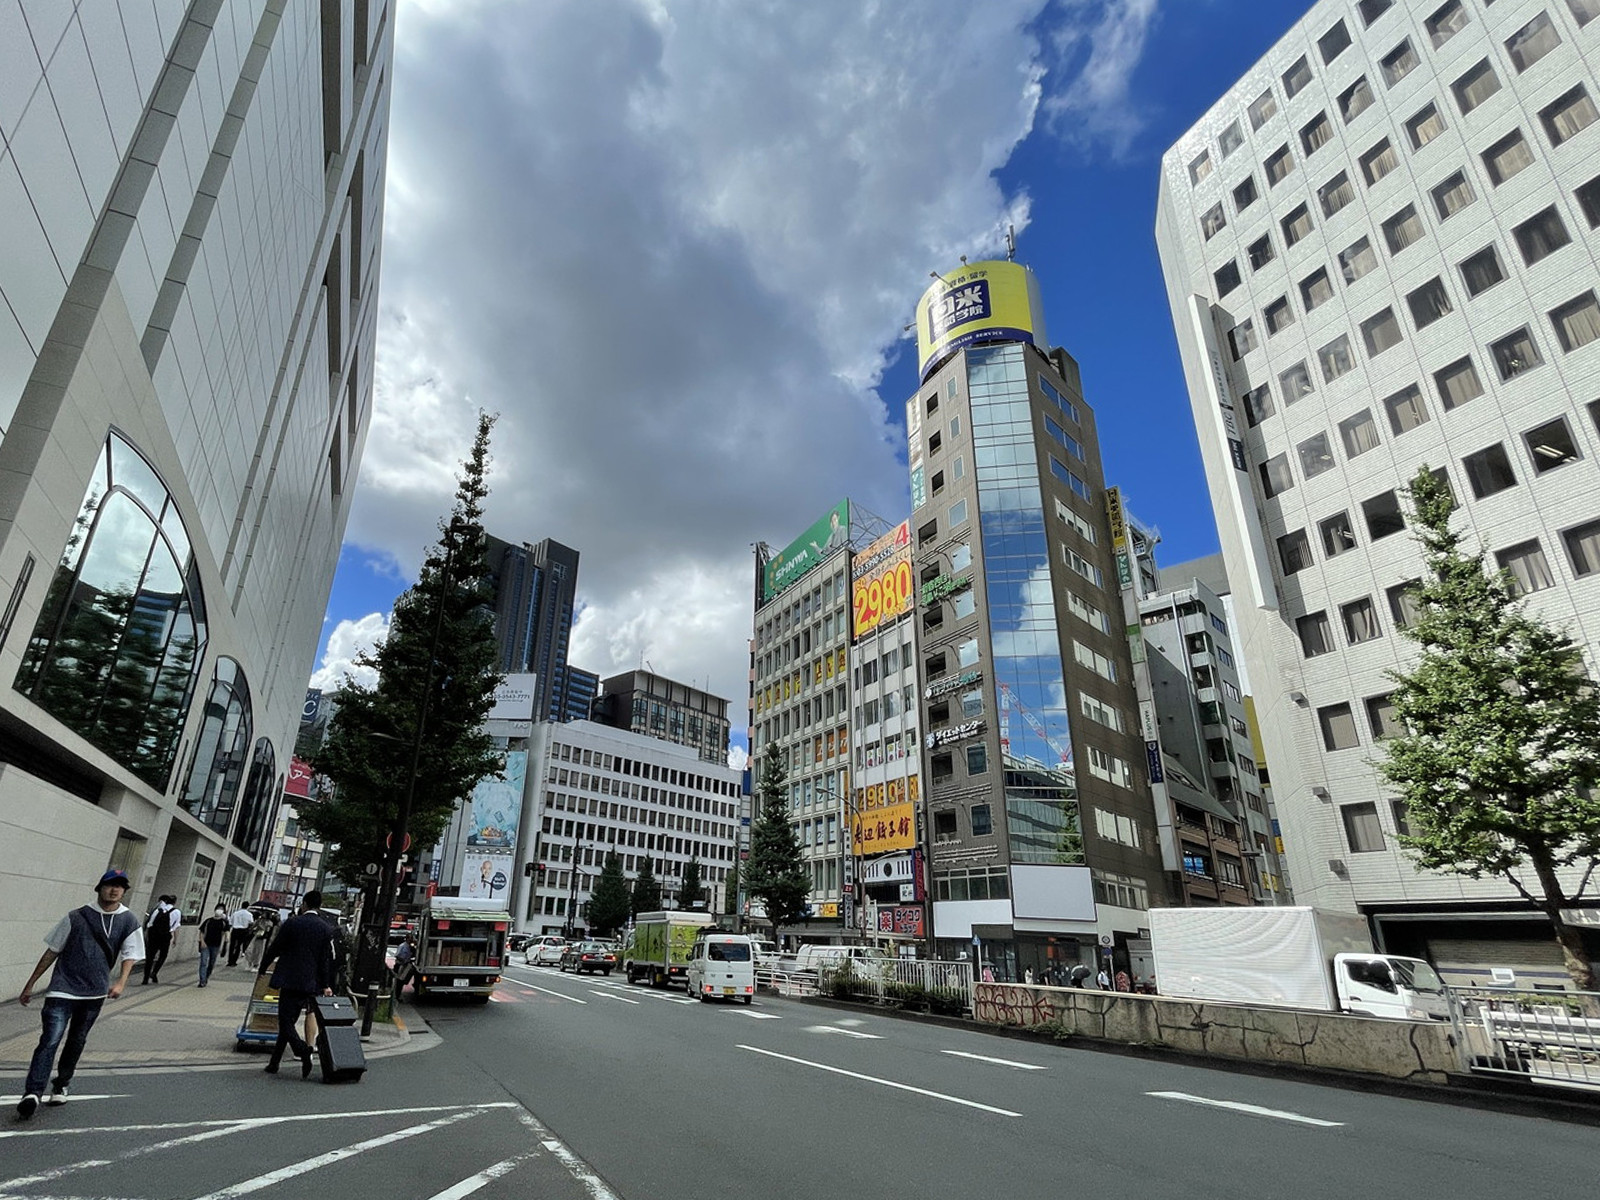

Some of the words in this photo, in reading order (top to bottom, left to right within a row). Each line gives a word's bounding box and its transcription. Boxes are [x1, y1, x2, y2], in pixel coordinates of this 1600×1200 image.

[1223, 411, 1236, 436] TBC
[895, 523, 910, 546] 4
[853, 560, 912, 637] 2980
[879, 911, 893, 932] 薬
[896, 908, 921, 922] ダイコク
